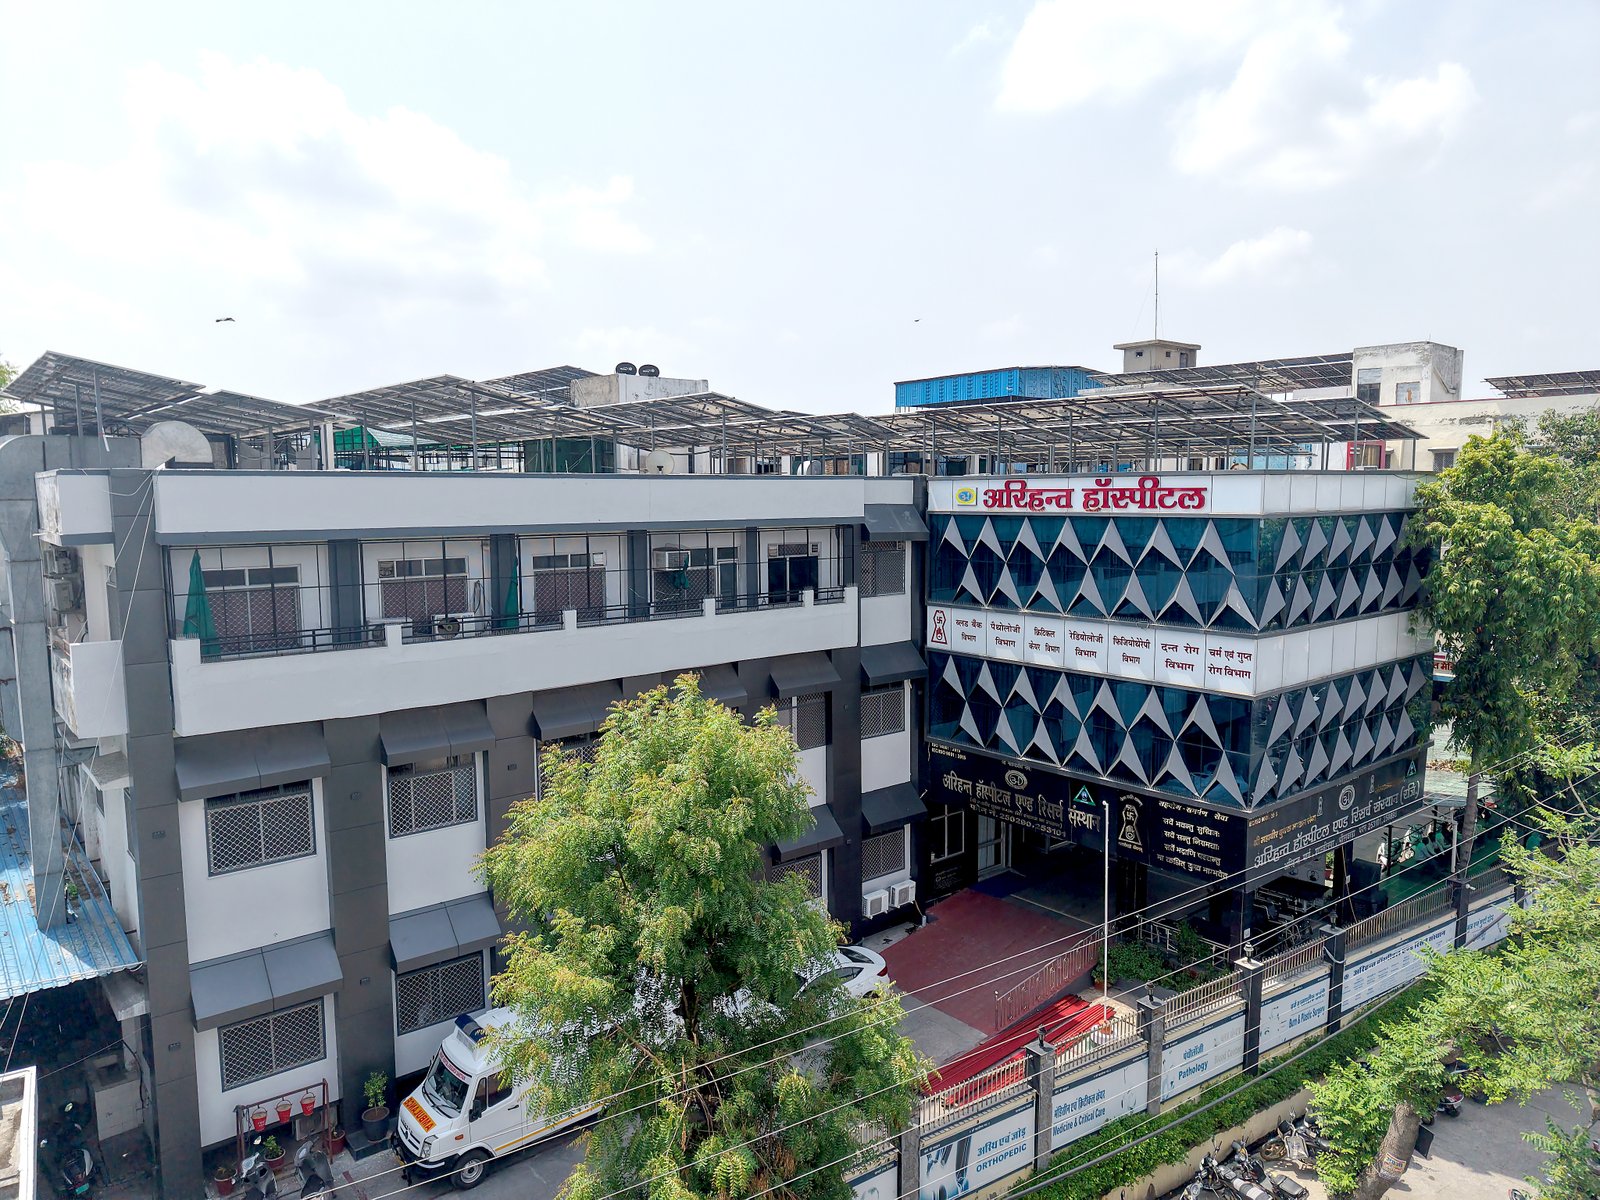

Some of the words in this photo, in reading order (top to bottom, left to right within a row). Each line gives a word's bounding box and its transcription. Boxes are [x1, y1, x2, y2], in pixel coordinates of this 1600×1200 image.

[983, 480, 1074, 512] अरिहन्त
[1082, 476, 1207, 512] हॉस्पीटल
[961, 632, 977, 642] विभाग
[995, 636, 1016, 648] विभाग
[1069, 629, 1103, 644] रेडियोलोजी
[1044, 643, 1060, 653] विभाग
[1075, 647, 1097, 659] विभाग
[1161, 643, 1178, 653] दन्त
[1184, 643, 1200, 655] रोग
[1208, 647, 1222, 657] चर्म
[1225, 649, 1234, 661] एवं
[1236, 651, 1252, 664] गुप्त
[1122, 653, 1140, 664] विभाग
[1165, 659, 1194, 672] विभाग
[1208, 664, 1222, 676] रोग
[1224, 666, 1251, 679] विभाग
[942, 770, 972, 796] अरिहन्त
[976, 779, 1011, 806] हॉस्पीटल
[1067, 804, 1101, 833] संस्थान
[1254, 842, 1290, 868] अरिहन्त
[1293, 824, 1330, 854] हॉस्पीटल
[1178, 1060, 1208, 1080] Pathology
[1053, 1120, 1073, 1136] Medicine
[1073, 1117, 1078, 1127] &
[1078, 1109, 1095, 1126] Critical
[1095, 1107, 1105, 1118] Care
[999, 1131, 1011, 1147] एवं
[976, 1143, 1027, 1172] ORTHOPEDIC
